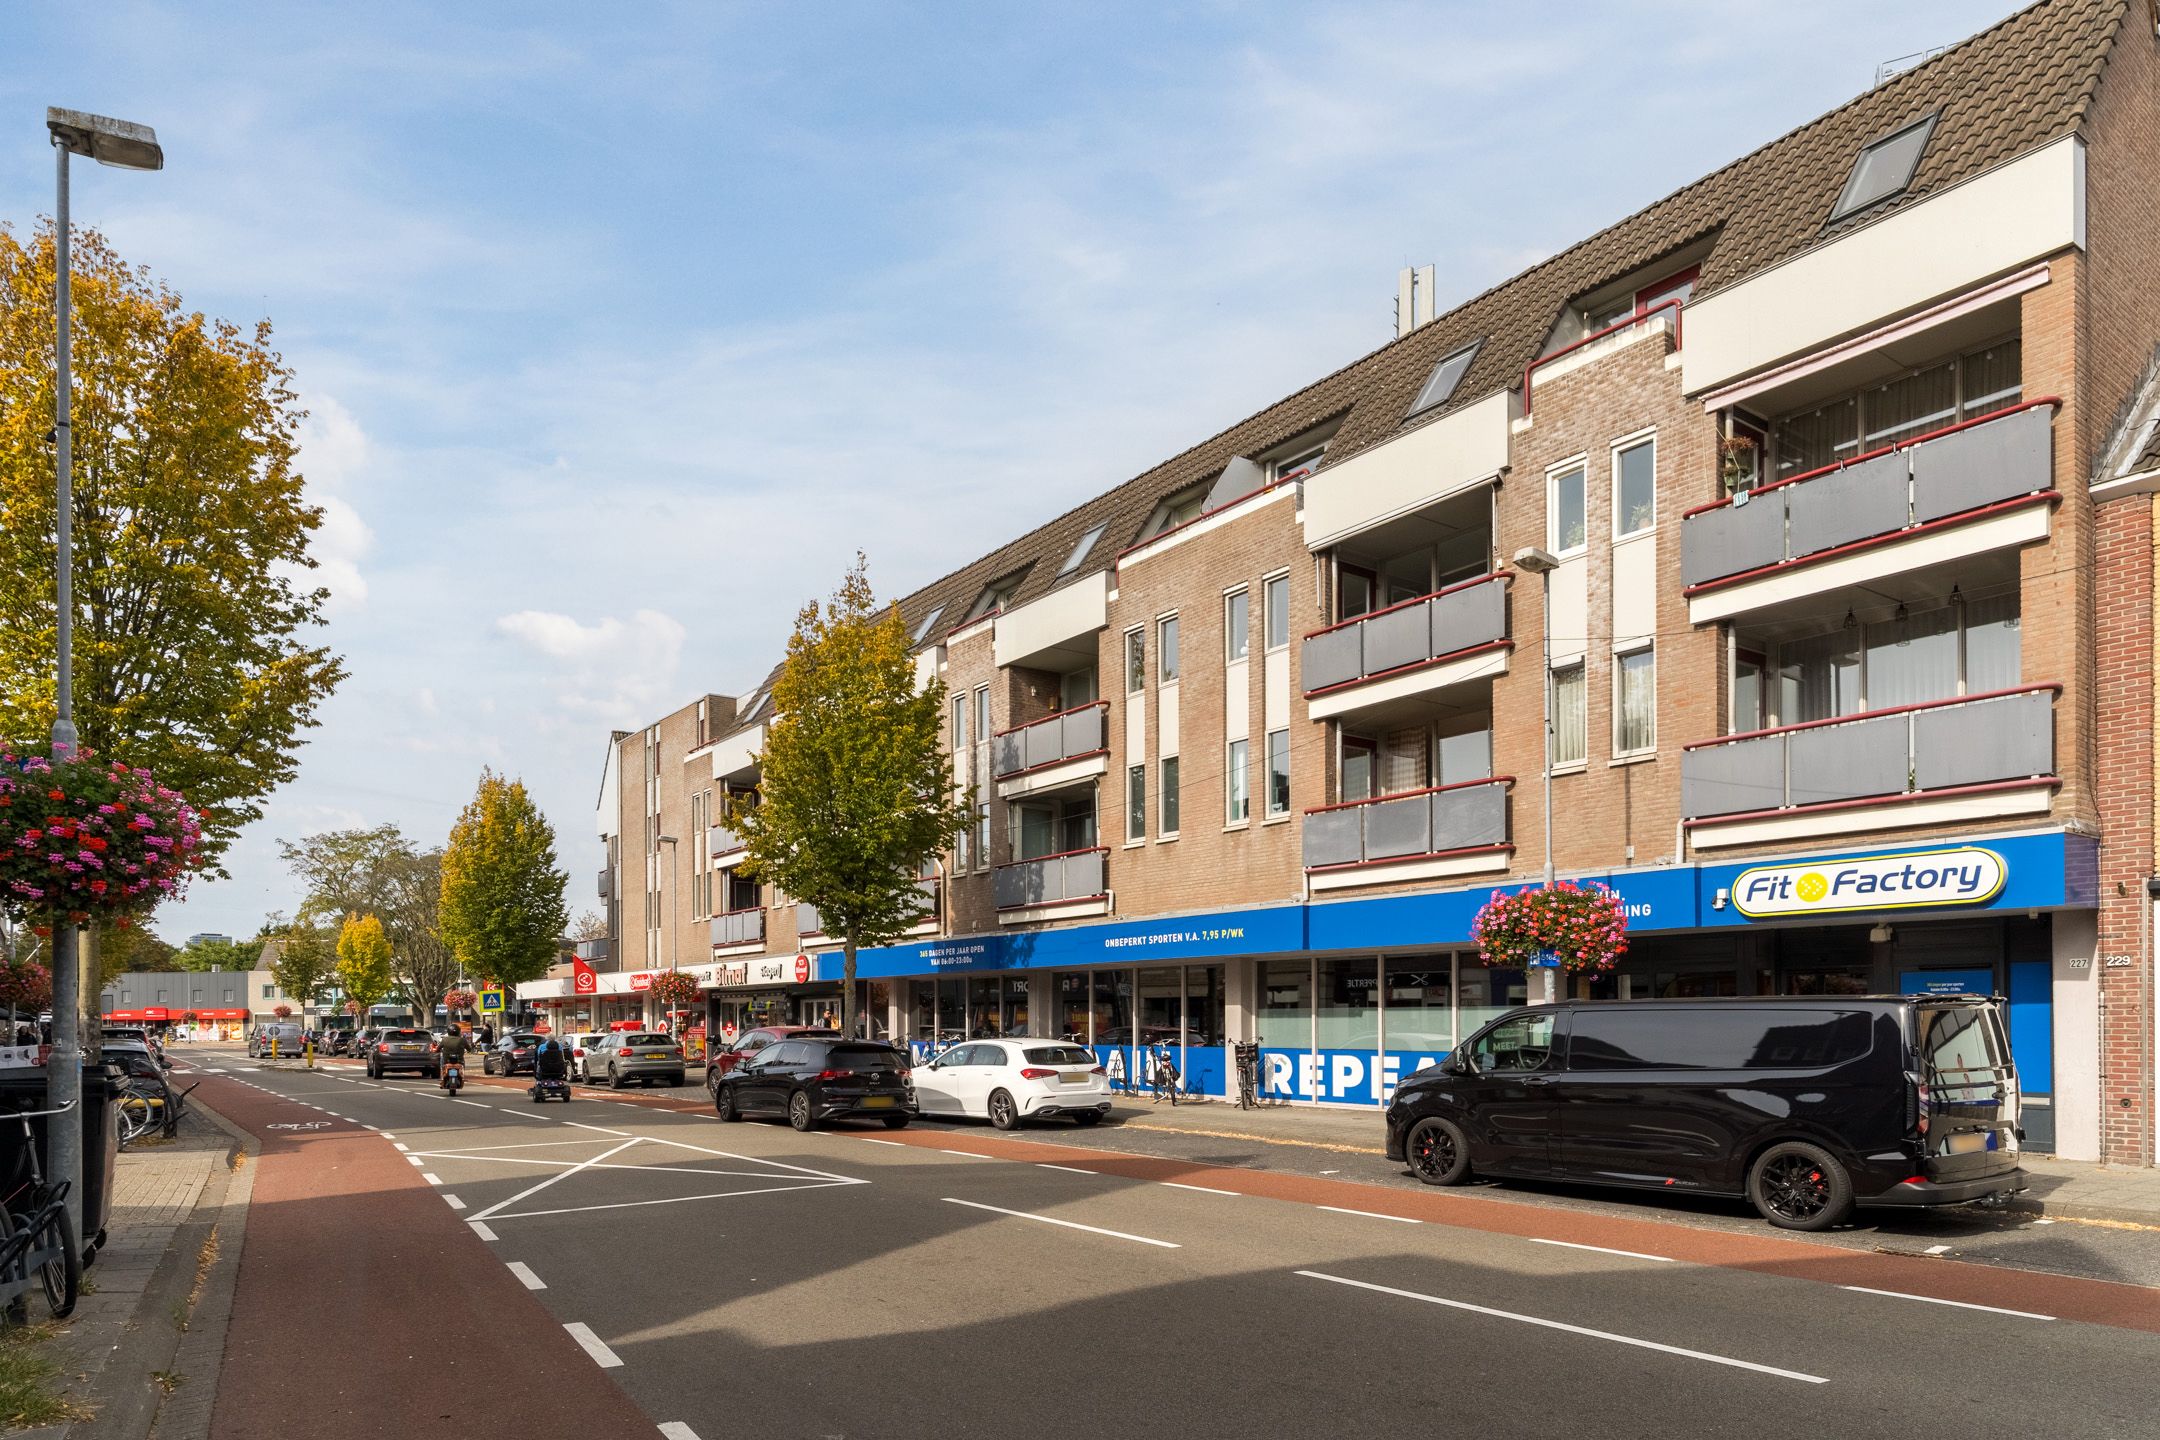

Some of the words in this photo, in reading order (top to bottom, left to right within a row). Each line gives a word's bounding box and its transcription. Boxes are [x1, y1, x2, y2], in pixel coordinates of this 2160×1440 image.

[1746, 875, 1792, 902] Fit
[1831, 864, 1982, 896] Factory
[1105, 936, 1146, 948] ONBEPERKT
[1149, 933, 1182, 944] SPORTEN
[1185, 932, 1200, 942] V.A.
[1202, 930, 1219, 941] 7,95
[1221, 928, 1244, 939] P/WK
[929, 949, 945, 957] DAGEN
[957, 946, 969, 954] JAAR
[970, 945, 984, 953] OPEN
[931, 958, 940, 966] VAN
[2070, 960, 2087, 968] 227
[2106, 956, 2131, 966] 229
